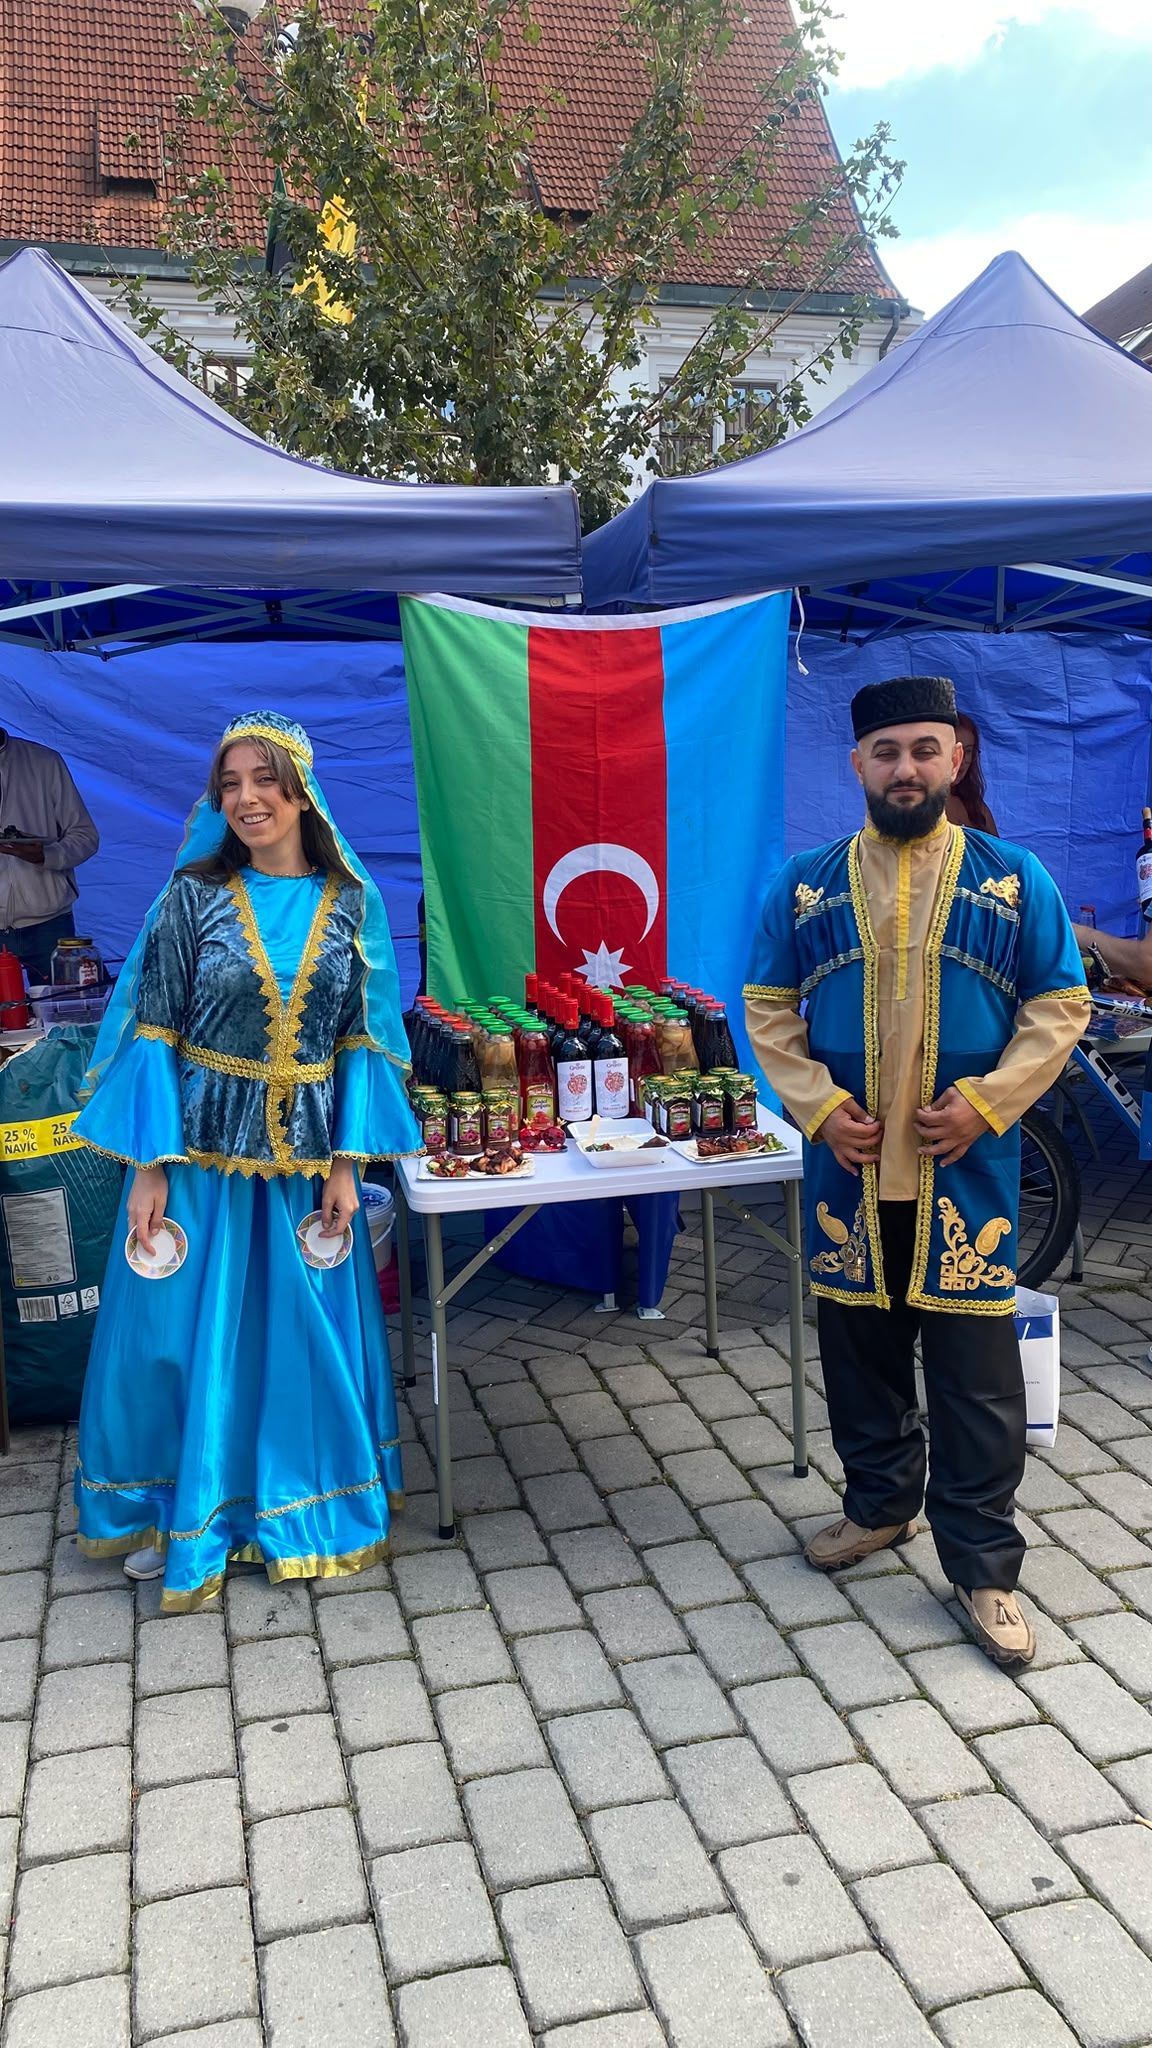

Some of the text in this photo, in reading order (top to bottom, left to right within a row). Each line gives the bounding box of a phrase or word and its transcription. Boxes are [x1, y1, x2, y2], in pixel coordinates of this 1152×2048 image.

[4, 1128, 35, 1142] 25 %
[51, 1122, 67, 1135] 25
